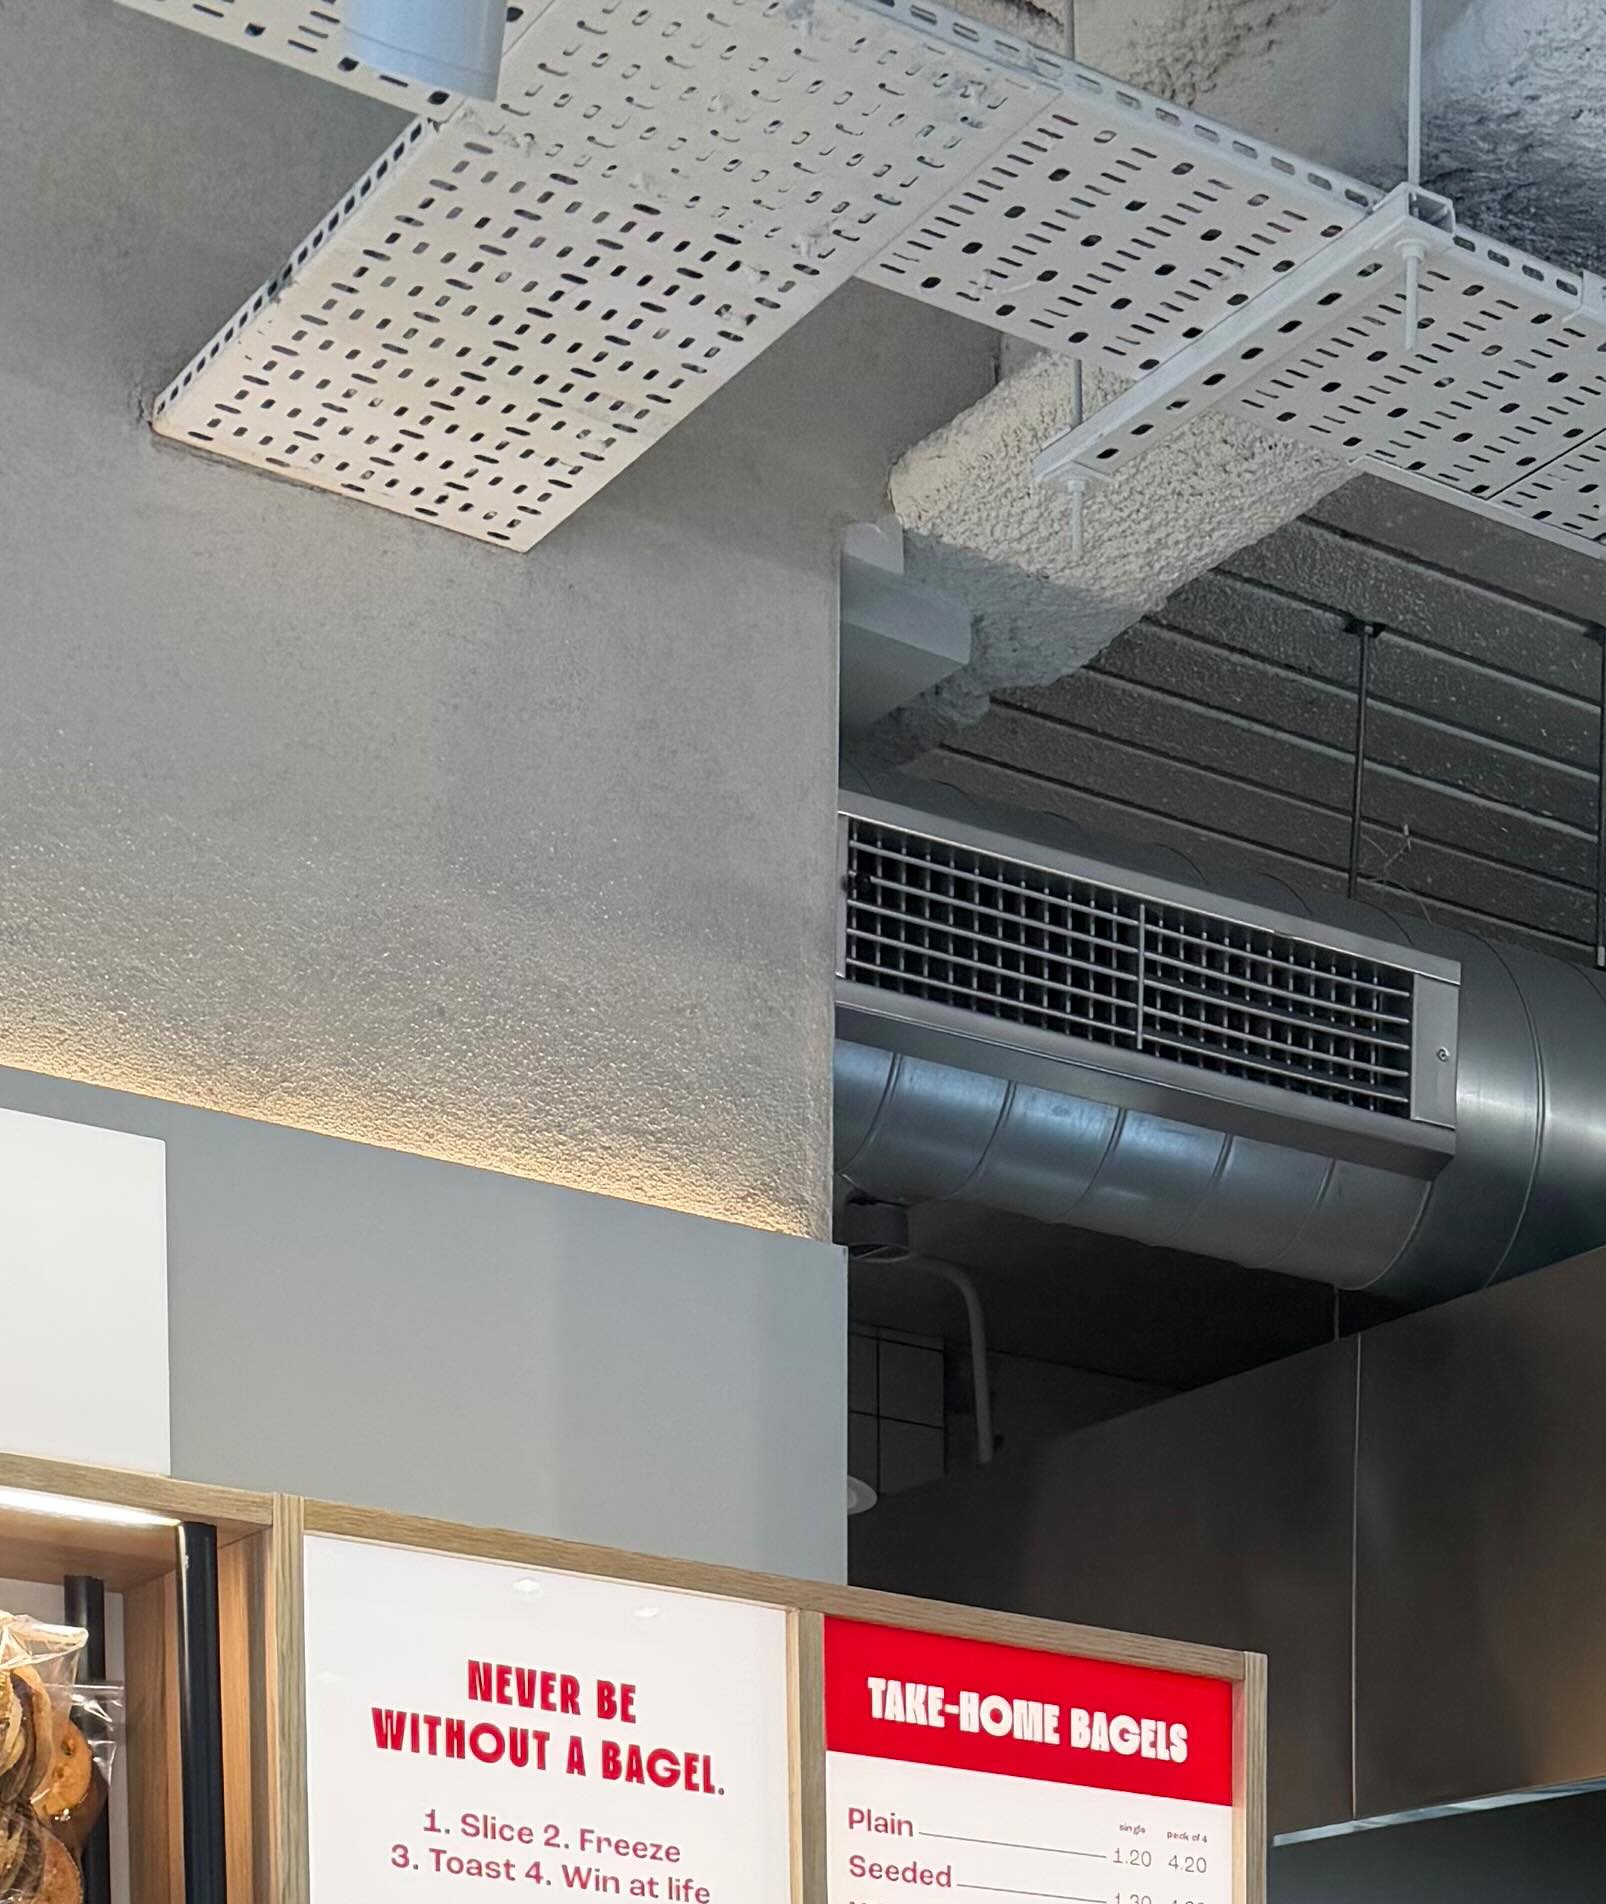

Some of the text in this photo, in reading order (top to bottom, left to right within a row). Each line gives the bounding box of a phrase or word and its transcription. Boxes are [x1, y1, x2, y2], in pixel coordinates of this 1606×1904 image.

[467, 1658, 637, 1725] NEVER BE
[867, 1676, 1188, 1763] TAKE-HOME BAGELS
[371, 1706, 725, 1796] WITHOUT A BAGEL.
[423, 1808, 681, 1864] 1. Slice 2. Freeze
[847, 1807, 1207, 1874] Plain 1.20 4.20
[391, 1843, 711, 1904] 3. Toast 4. Win at life
[848, 1854, 952, 1889] Seeded
